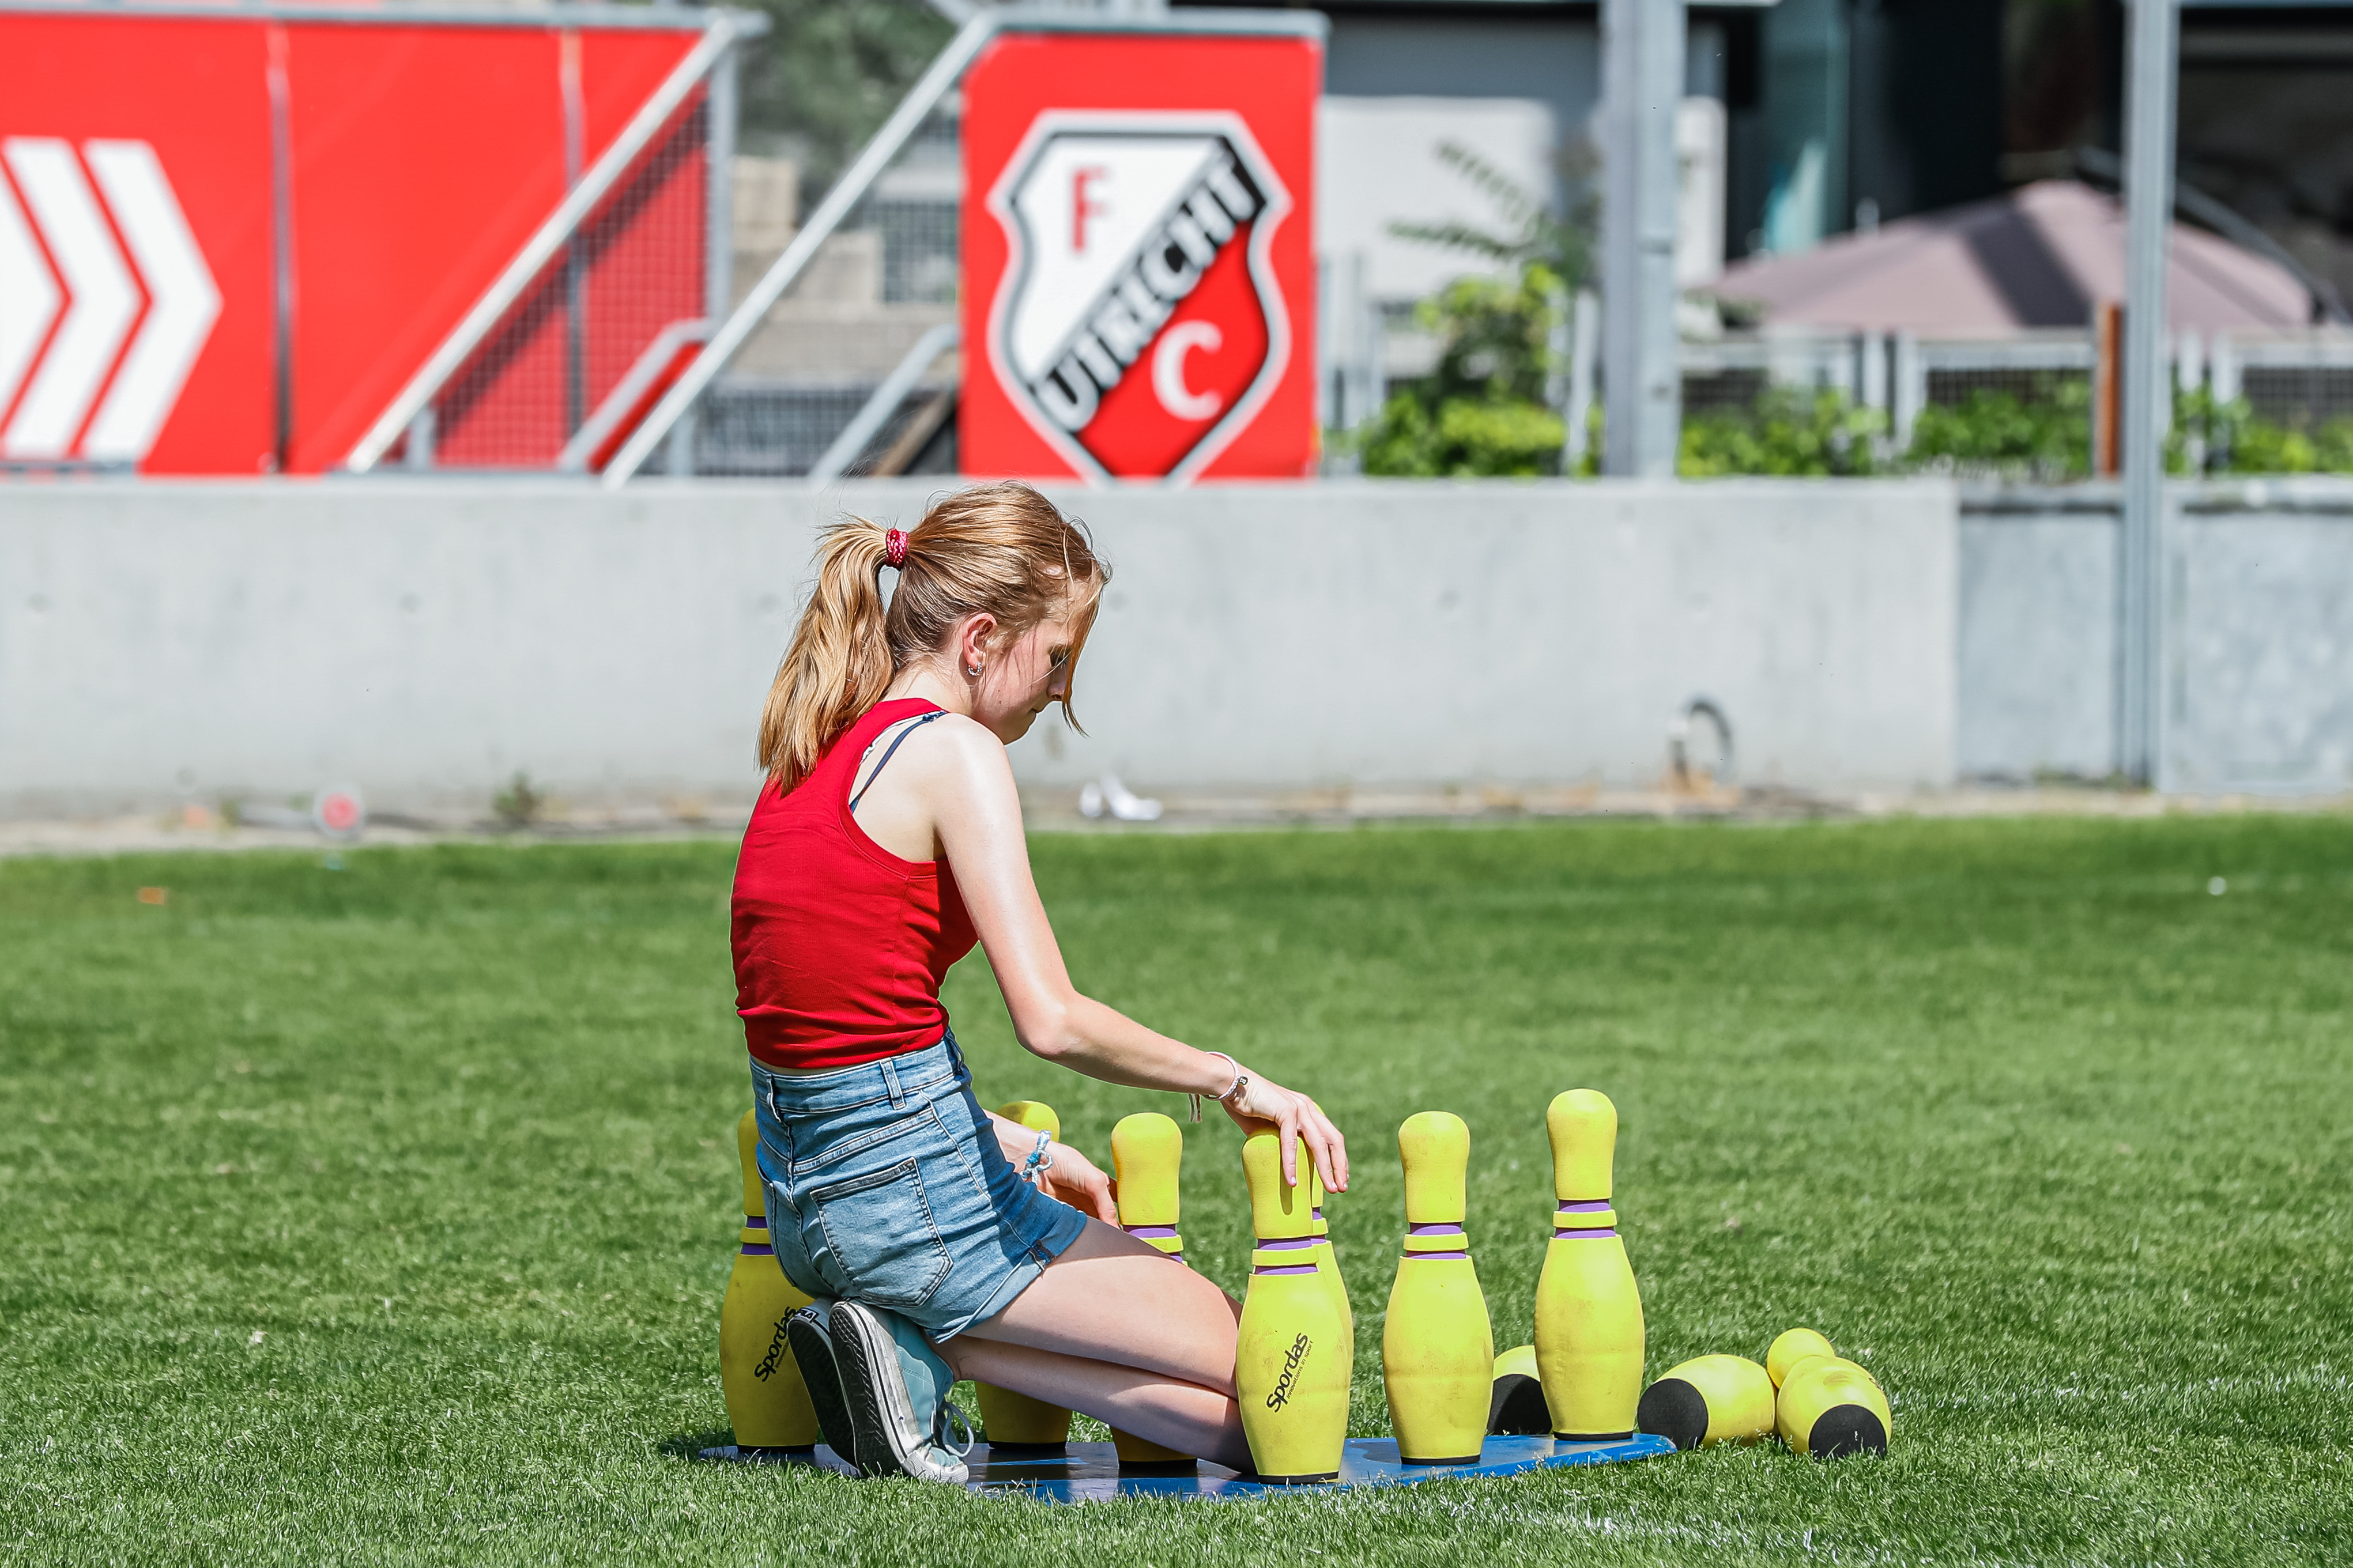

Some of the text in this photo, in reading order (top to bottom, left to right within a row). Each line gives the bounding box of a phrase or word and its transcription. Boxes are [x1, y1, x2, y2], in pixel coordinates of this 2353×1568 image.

[1072, 165, 1108, 253] F
[1036, 151, 1255, 432] UTRECHT
[1151, 319, 1223, 422] C
[1266, 1332, 1308, 1413] Spordas
[1286, 1366, 1303, 1399] innovations
[1304, 1340, 1314, 1358] sport
